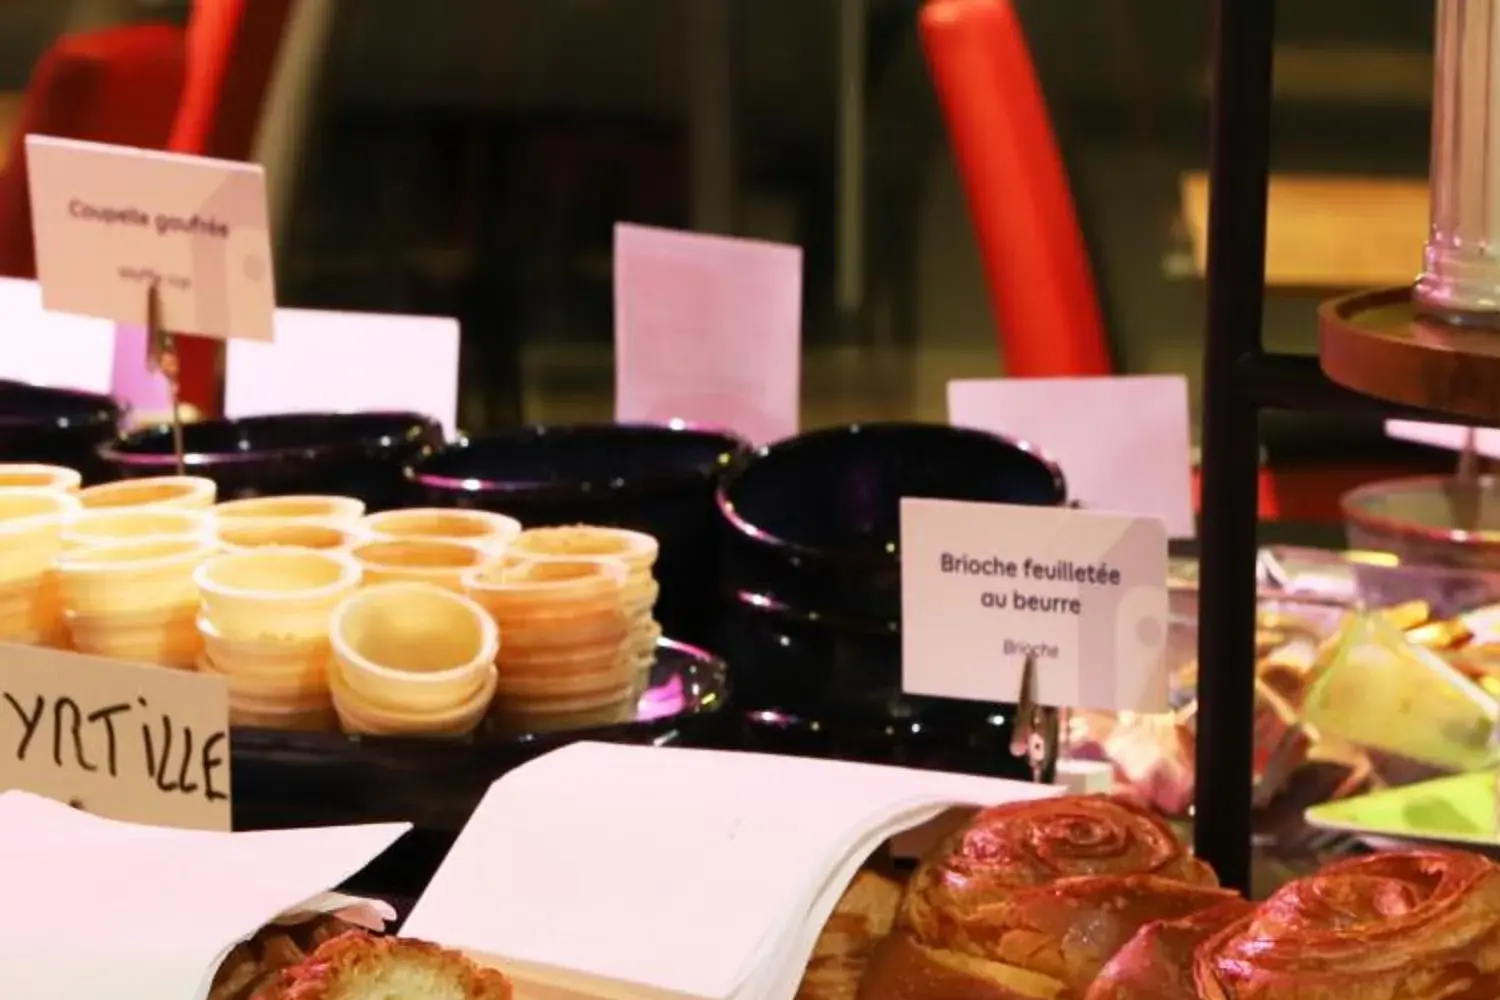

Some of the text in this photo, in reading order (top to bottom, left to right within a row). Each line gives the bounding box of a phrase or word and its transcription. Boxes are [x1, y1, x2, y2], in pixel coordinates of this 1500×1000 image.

[940, 552, 1121, 585] Brioche feuilletée
[980, 589, 1082, 615] au beurre
[1003, 639, 1060, 659] Brioche
